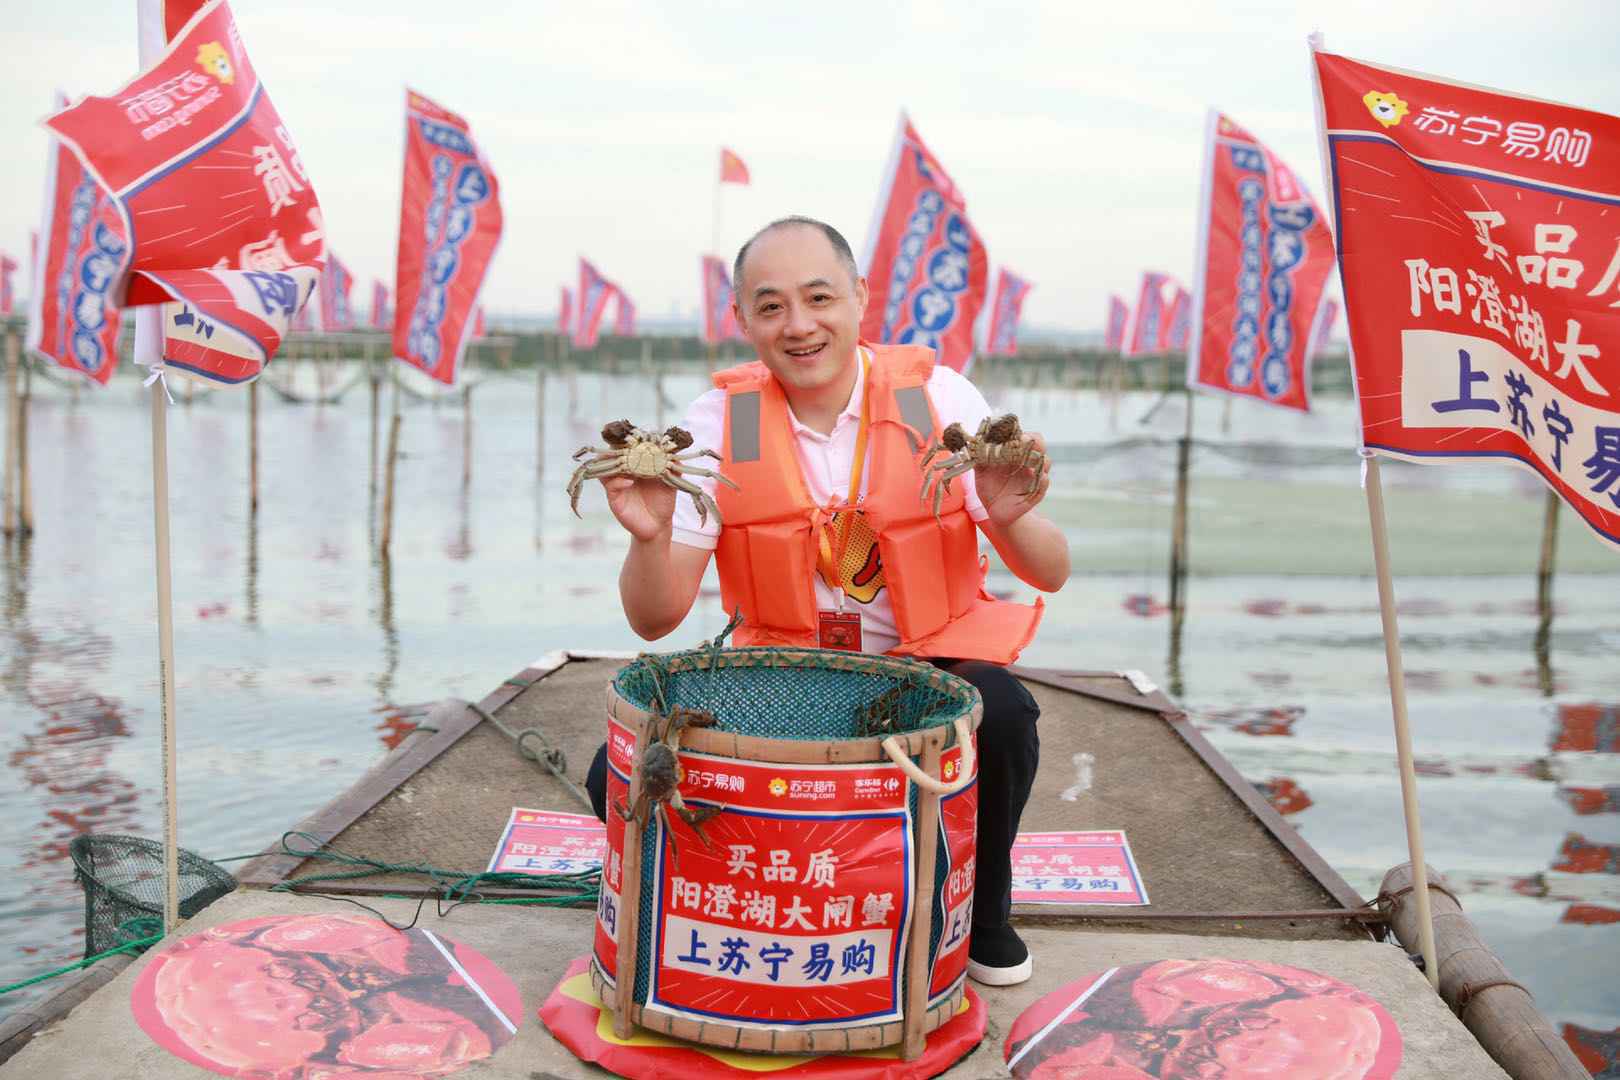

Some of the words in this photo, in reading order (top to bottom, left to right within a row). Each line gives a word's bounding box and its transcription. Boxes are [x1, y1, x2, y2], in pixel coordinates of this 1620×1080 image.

[1412, 105, 1593, 168] 苏宁易购
[1404, 257, 1611, 398] 阳澄湖大
[687, 769, 746, 793] 苏宁易购
[789, 780, 837, 793] 苏宁超市
[789, 791, 836, 800] suning.com
[727, 844, 840, 888] 买品质
[670, 876, 896, 931] 阳澄湖大闸蟹
[677, 928, 876, 982] 上苏宁易购
